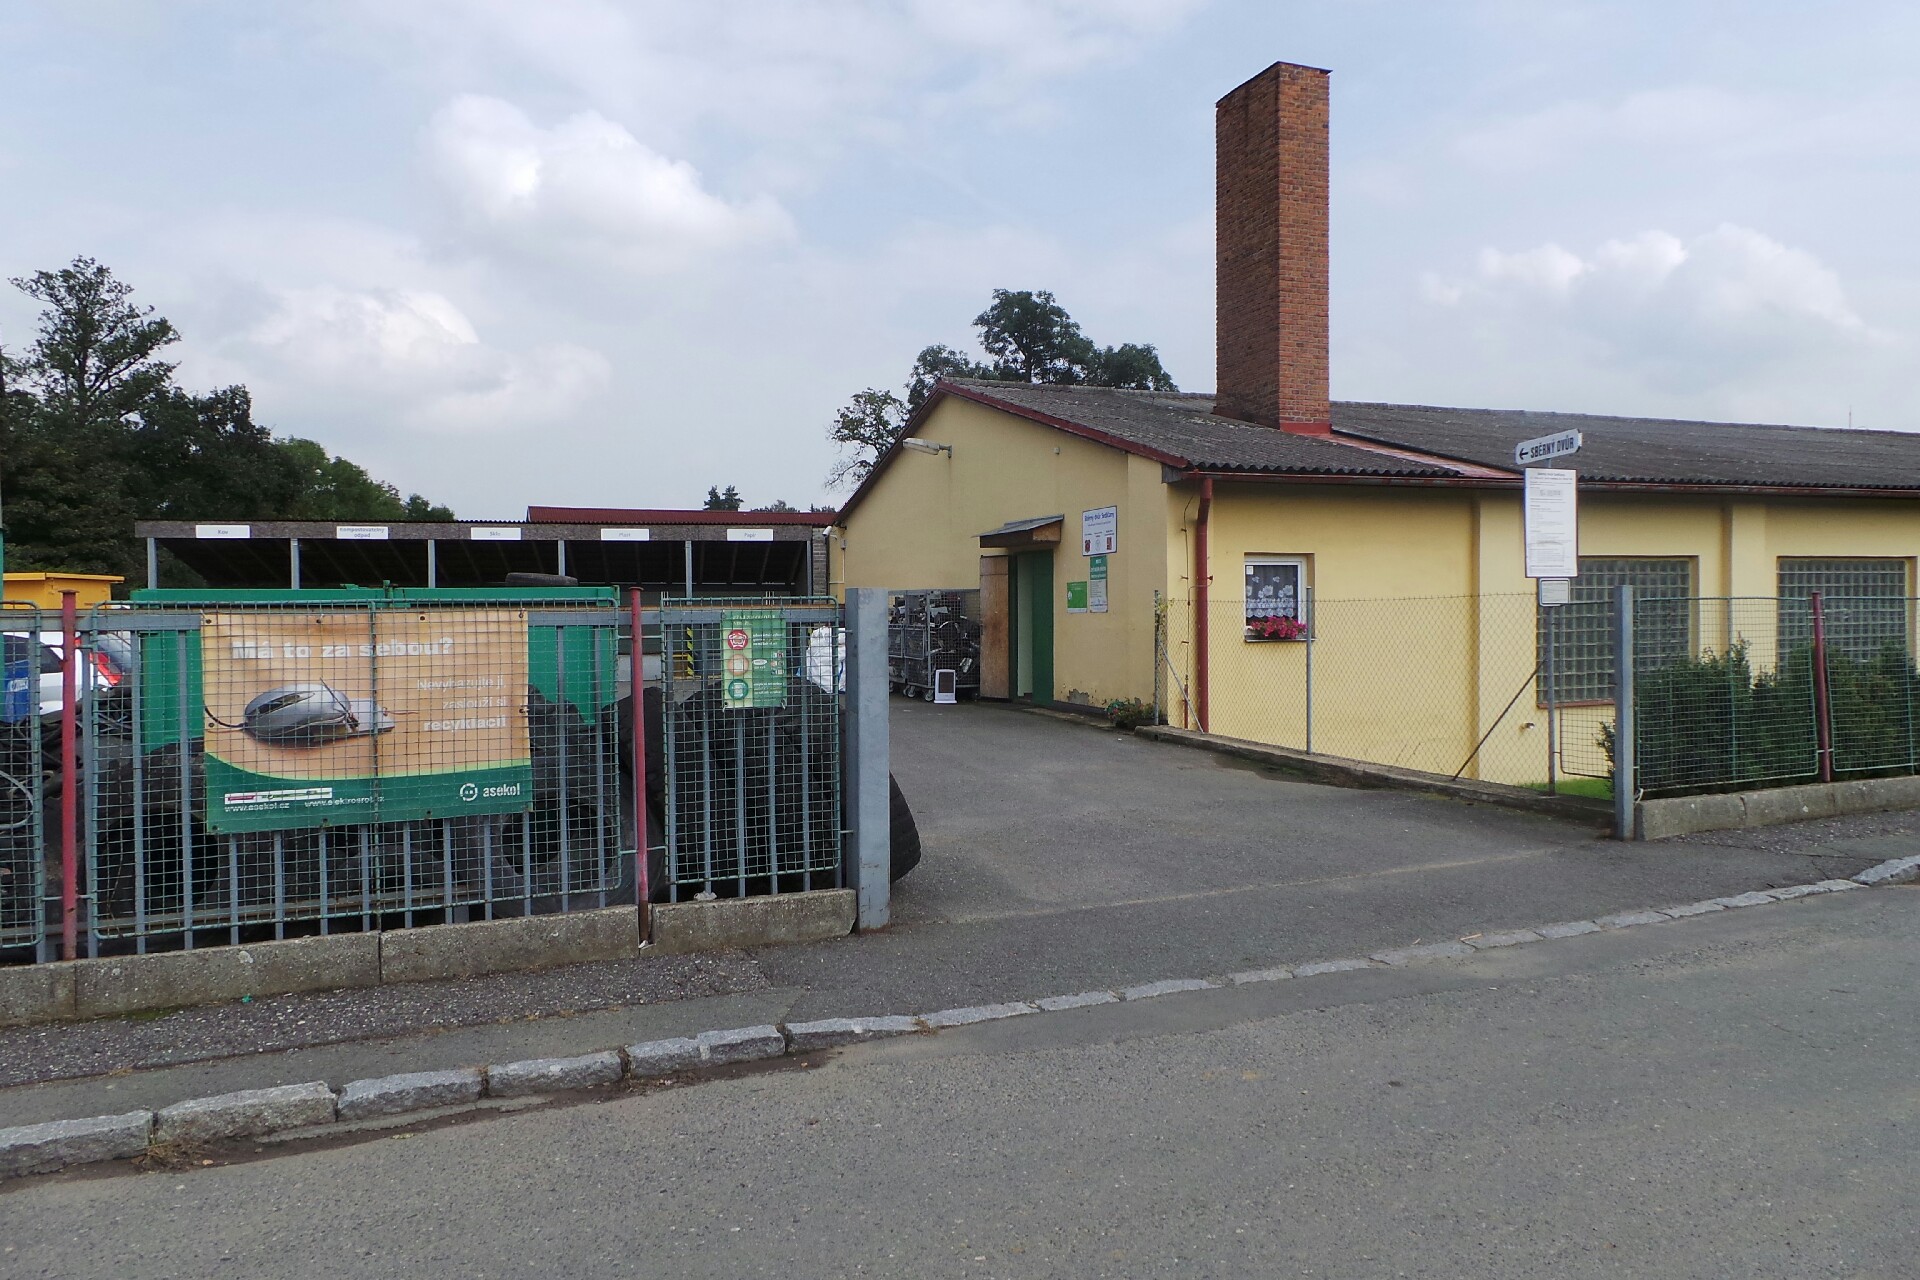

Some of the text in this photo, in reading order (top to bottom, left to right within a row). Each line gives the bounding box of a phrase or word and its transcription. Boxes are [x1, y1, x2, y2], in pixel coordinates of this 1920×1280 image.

[1530, 435, 1574, 459] SBĚRNÝ DVŮR
[231, 636, 454, 660] Má to za sebou?
[496, 696, 507, 707] si
[483, 782, 520, 798] asekol
